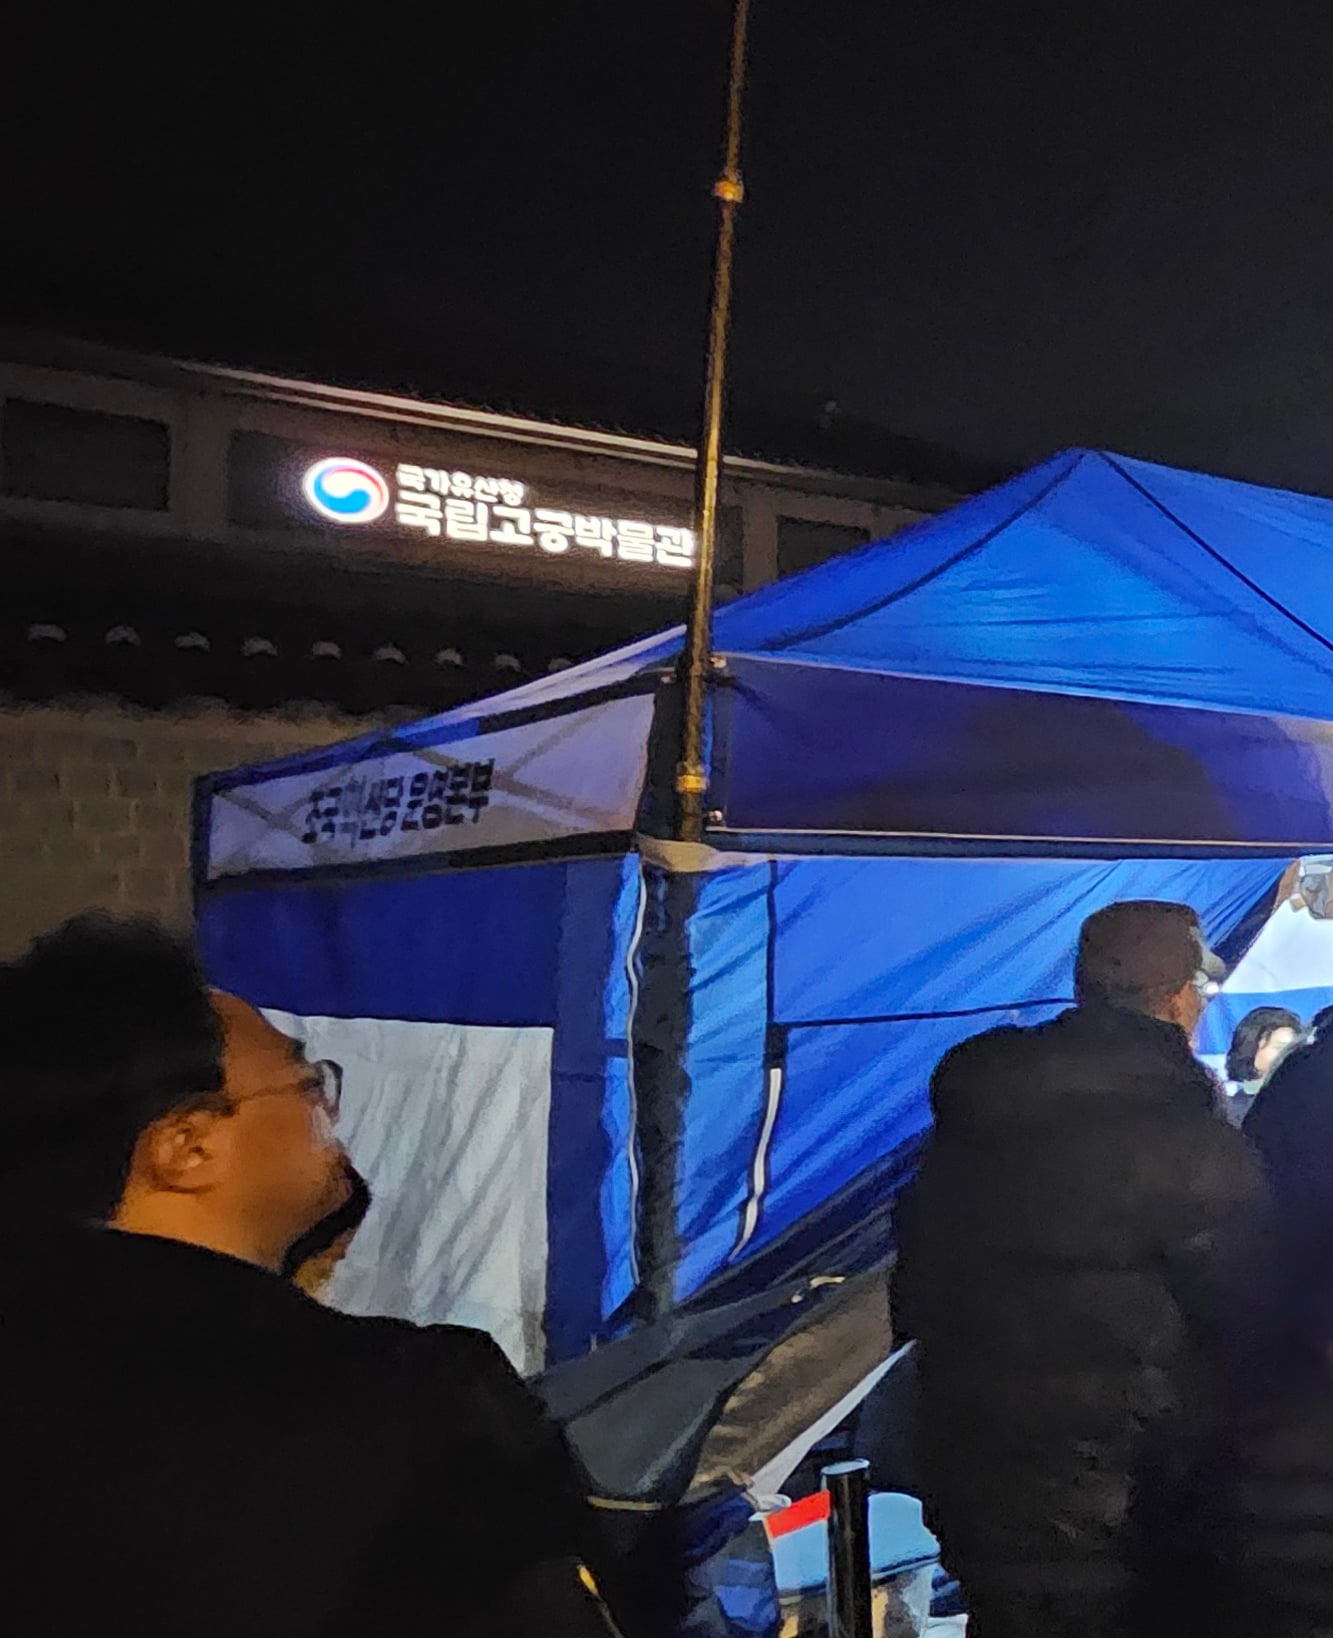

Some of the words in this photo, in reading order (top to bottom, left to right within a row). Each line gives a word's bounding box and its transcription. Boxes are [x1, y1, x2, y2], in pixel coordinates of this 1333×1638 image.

[396, 463, 526, 505] 국가유산청
[396, 491, 695, 567] 국립고궁박물관
[402, 757, 495, 831] 운영본부
